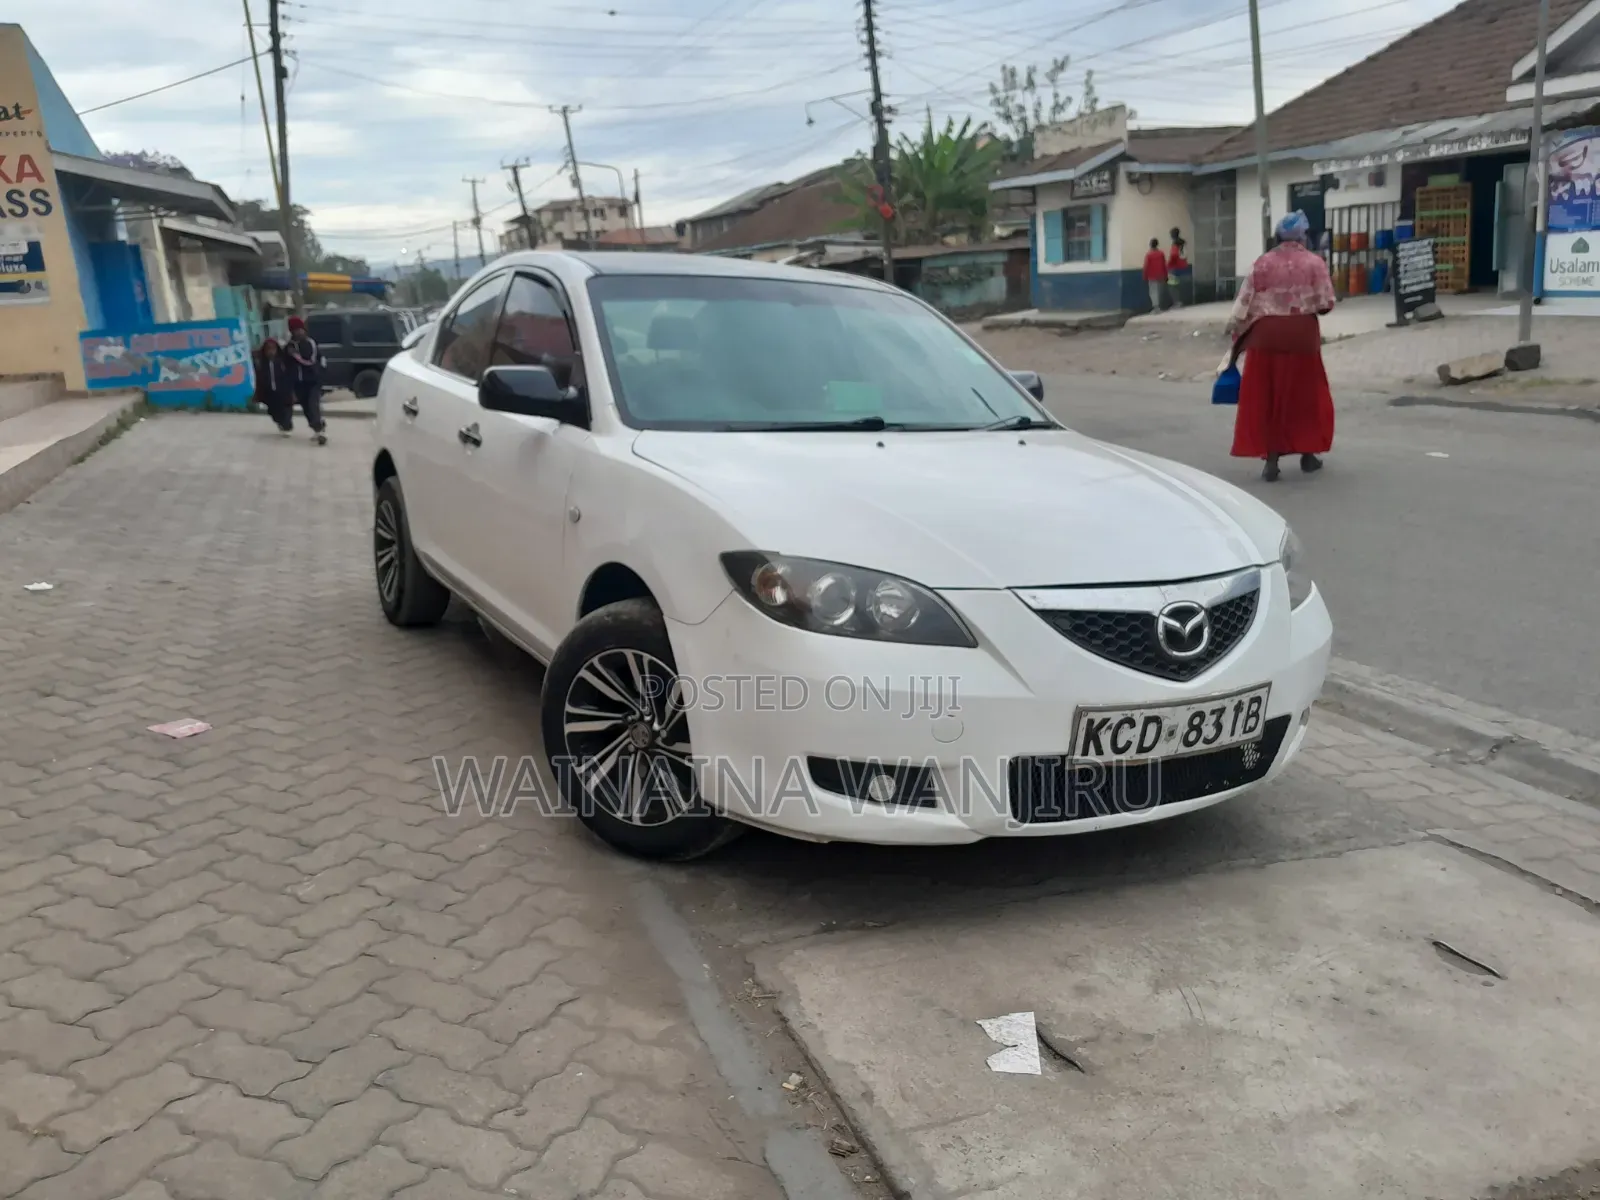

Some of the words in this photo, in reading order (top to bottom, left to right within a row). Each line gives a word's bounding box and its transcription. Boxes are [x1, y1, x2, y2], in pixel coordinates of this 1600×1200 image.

[1558, 275, 1595, 287] SCHEME
[1081, 715, 1163, 756] KCD
[1182, 695, 1263, 748] 831B
